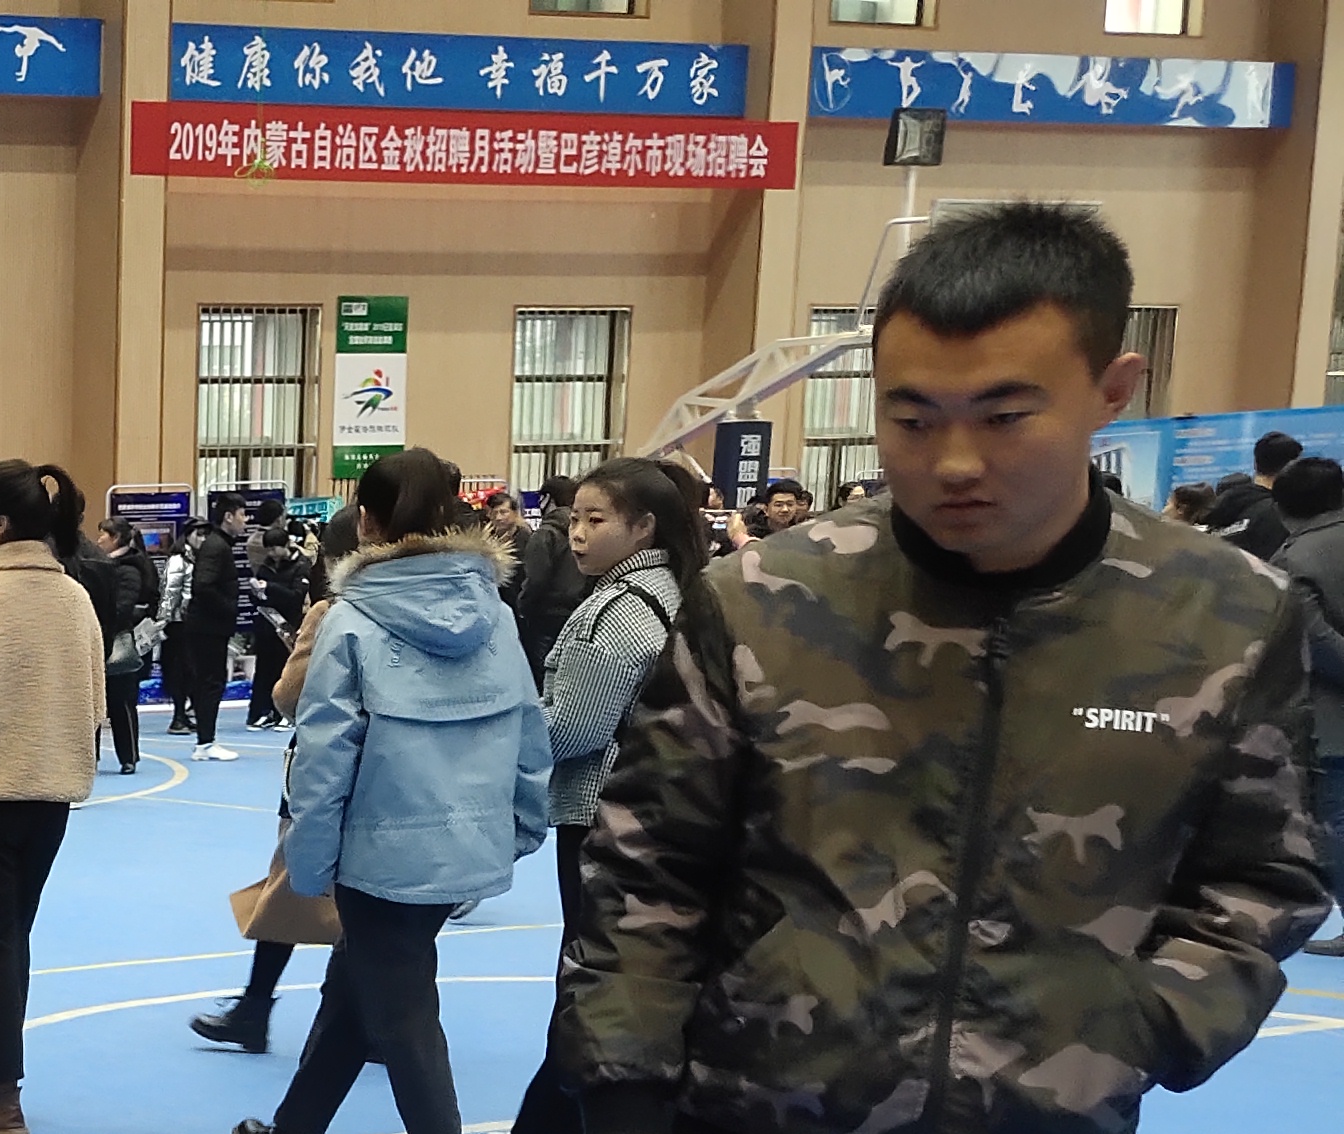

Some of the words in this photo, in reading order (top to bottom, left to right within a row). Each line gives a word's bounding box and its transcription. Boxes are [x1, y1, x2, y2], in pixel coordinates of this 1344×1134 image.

[180, 34, 443, 97] 健康你我他
[478, 47, 721, 107] 幸福千万家
[169, 118, 770, 180] 2019年内蒙古自治区金秋招聘月活动暨巴彦淖尔市现场招聘会
[1072, 706, 1170, 733] "SPIRIT"
